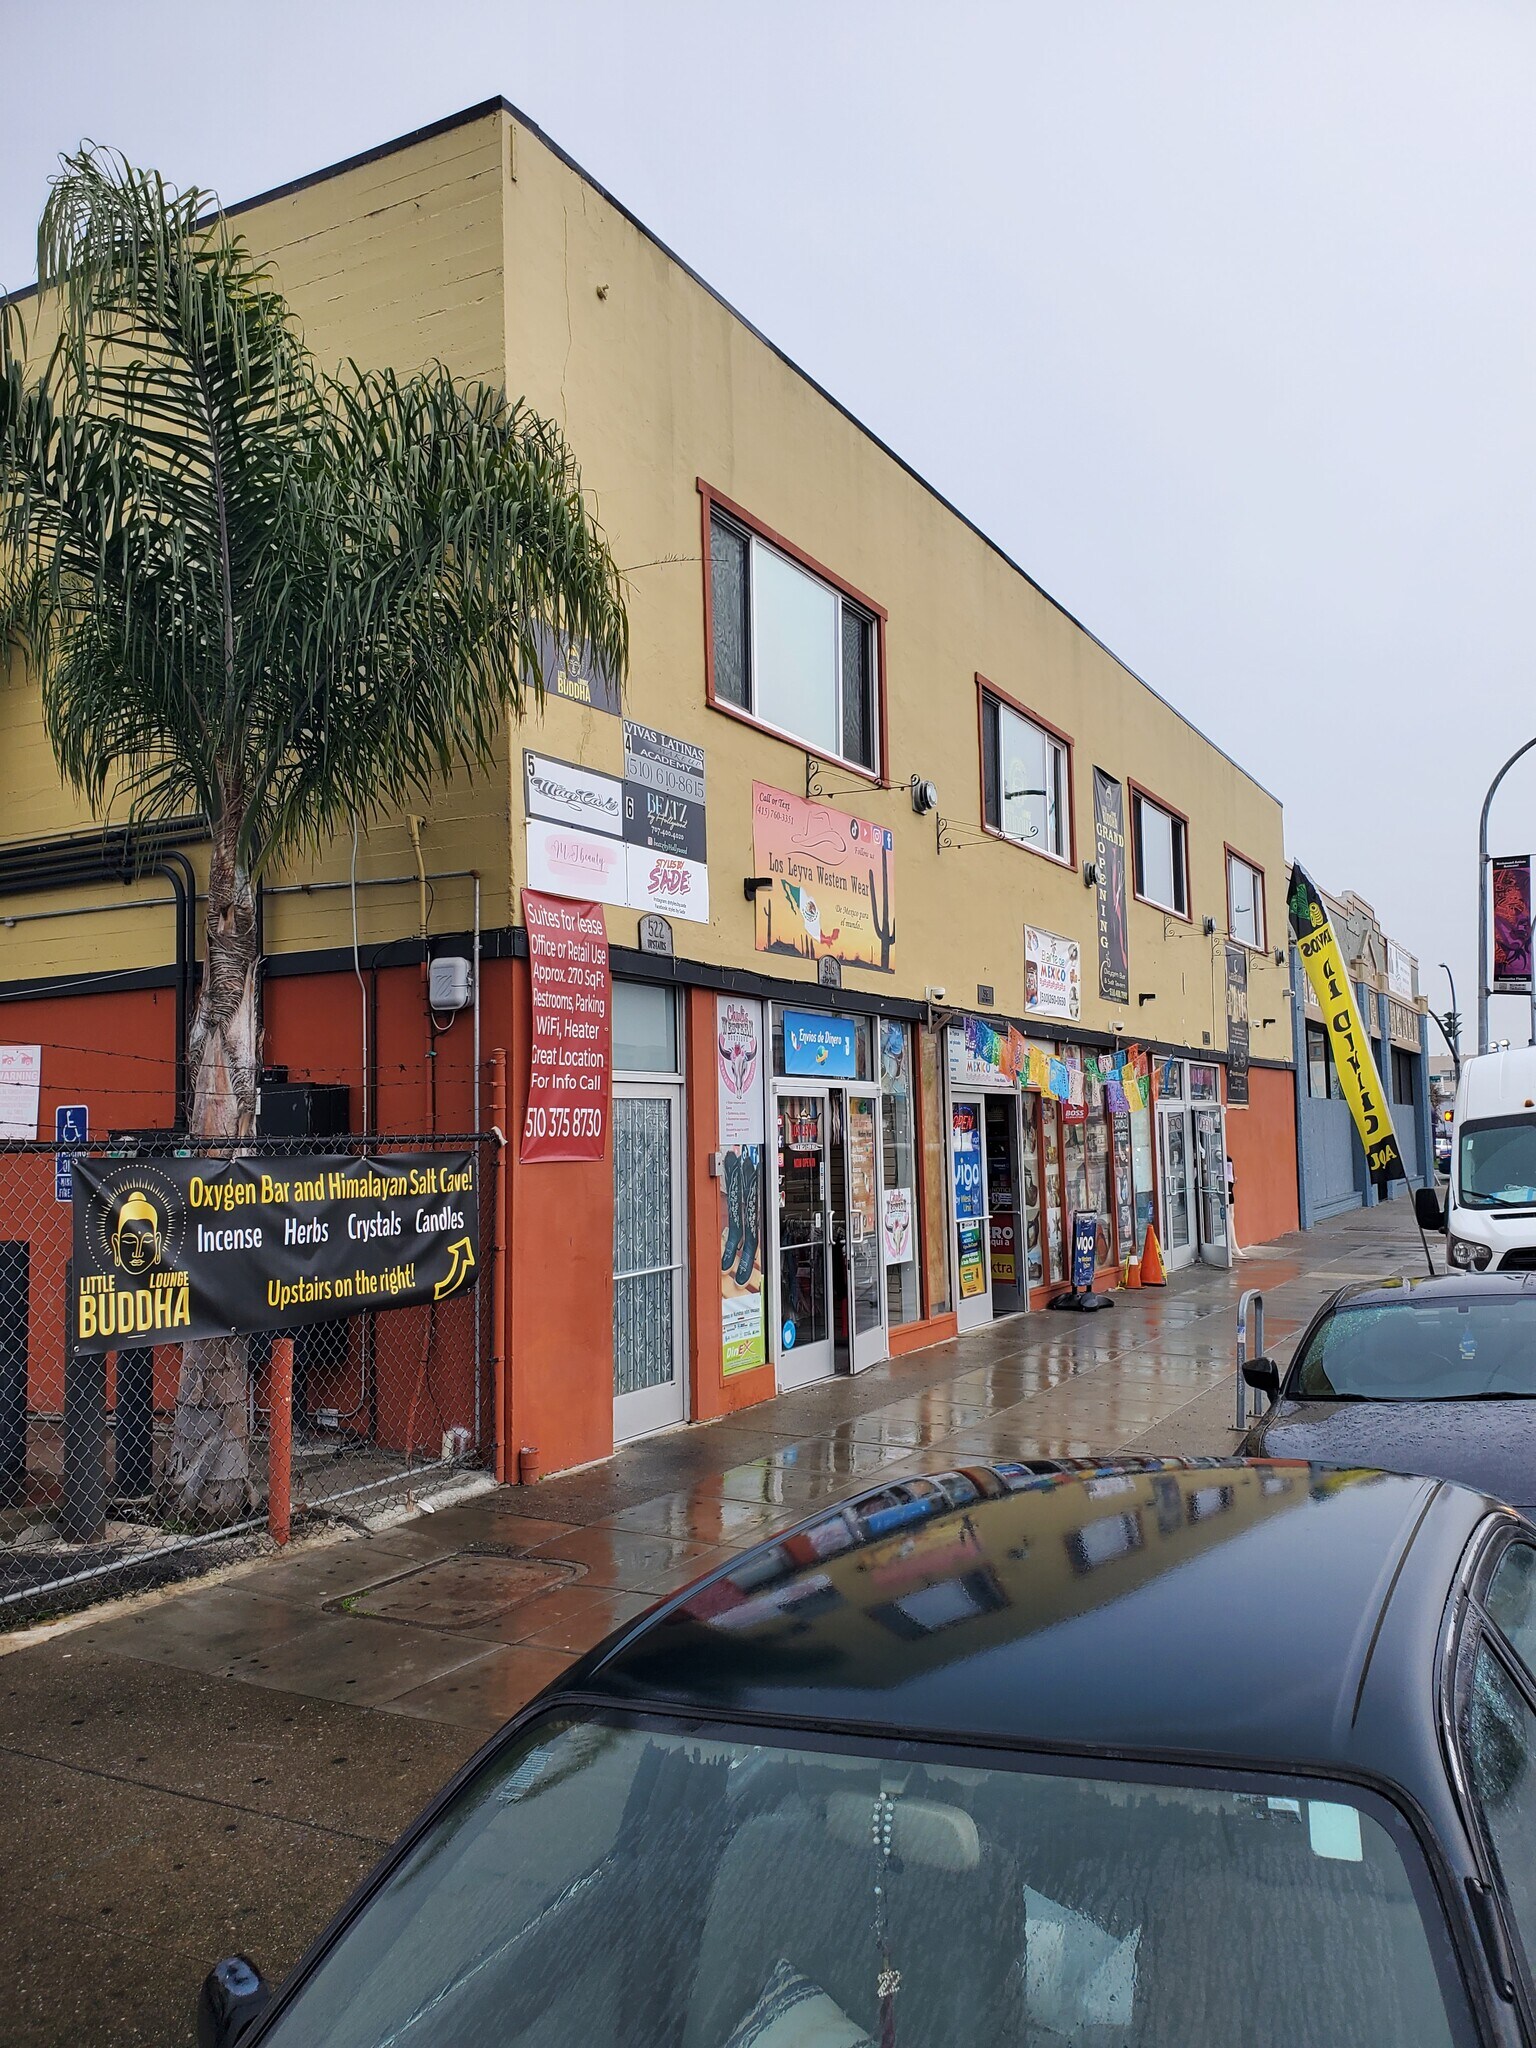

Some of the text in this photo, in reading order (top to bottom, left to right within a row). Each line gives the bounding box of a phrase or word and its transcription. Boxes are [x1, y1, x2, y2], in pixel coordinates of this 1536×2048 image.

[558, 678, 592, 703] BUDDHA
[624, 720, 704, 760] VIVAS LATINAS
[626, 734, 632, 754] 4
[528, 754, 535, 776] 5
[640, 748, 692, 772] ACADEMY
[627, 756, 704, 798] (510) 610-8615
[627, 798, 632, 818] 6
[647, 792, 688, 822] BEATZ
[756, 804, 794, 824] (415) 760-3351
[760, 792, 771, 803] Call
[778, 798, 790, 812] Text
[1096, 822, 1124, 848] GRAND
[656, 858, 684, 870] STYLES BY
[854, 846, 868, 859] Follow
[647, 868, 691, 895] SADE
[768, 852, 869, 897] Los Leyva Western Wear
[1098, 842, 1108, 949] OPENING
[527, 902, 603, 936] Suites for lease
[835, 904, 868, 920] De Mexico para
[840, 918, 846, 926] el
[648, 920, 664, 938] 522
[531, 934, 606, 965] Office or Retail Use
[533, 962, 604, 990] Approx. 270 SqFt
[1040, 964, 1066, 982] MEXICO
[533, 988, 605, 1018] Restrooms, Parking
[536, 1016, 600, 1040] WiFi, Heater
[798, 1028, 842, 1047] Envios de Dinero
[532, 1044, 604, 1068] Great Location
[531, 1073, 600, 1090] For Info Call
[525, 1107, 602, 1138] 510 375 8730
[954, 1116, 974, 1130] OPEN
[190, 1164, 473, 1211] Oxygen Bar and Himalayan Salt Cave!
[198, 1206, 464, 1252] Incense Herbs Crystals Candles
[991, 1226, 1014, 1240] RO
[1076, 1232, 1094, 1254] vigo
[80, 1270, 190, 1295] LITTLE LOUNGE
[267, 1263, 416, 1311] Upstairs on the right!
[79, 1286, 191, 1338] BUDDHA
